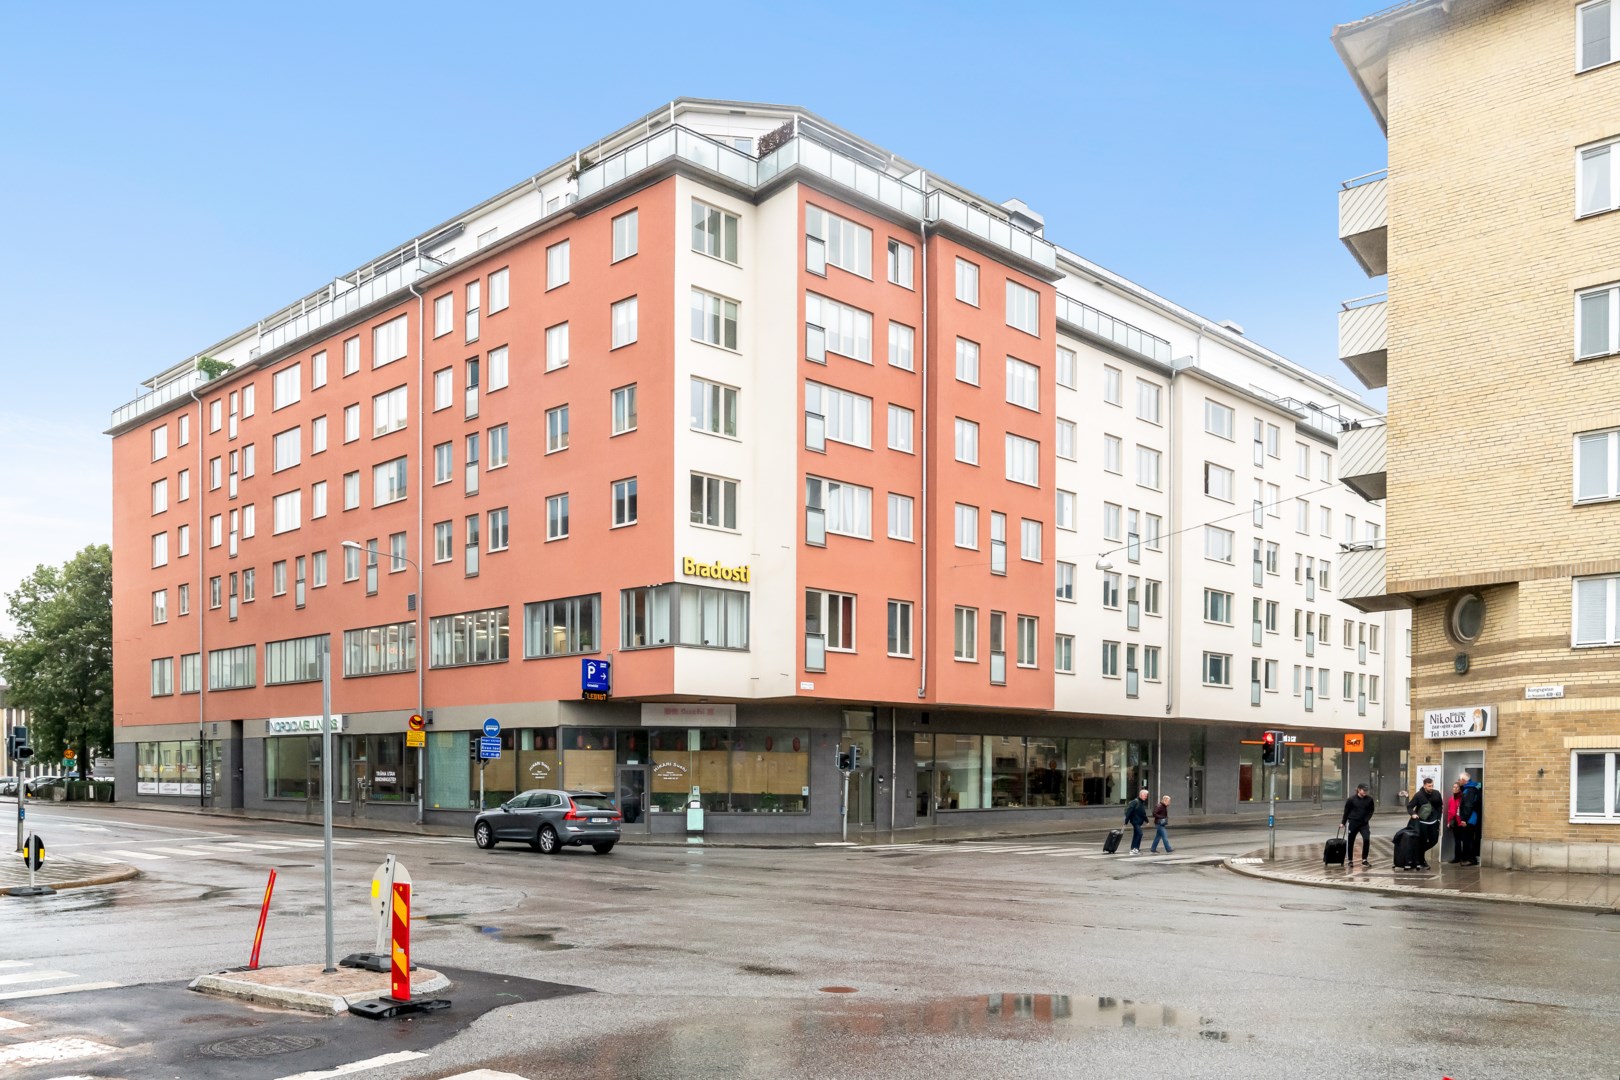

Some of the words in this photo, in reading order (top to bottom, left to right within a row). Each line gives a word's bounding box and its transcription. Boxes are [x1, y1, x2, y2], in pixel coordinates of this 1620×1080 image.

[683, 557, 751, 583] Bradosti
[588, 665, 596, 679] P
[1430, 730, 1440, 738] Tel
[653, 762, 672, 772] HIKARI
[673, 762, 688, 773] Sushi
